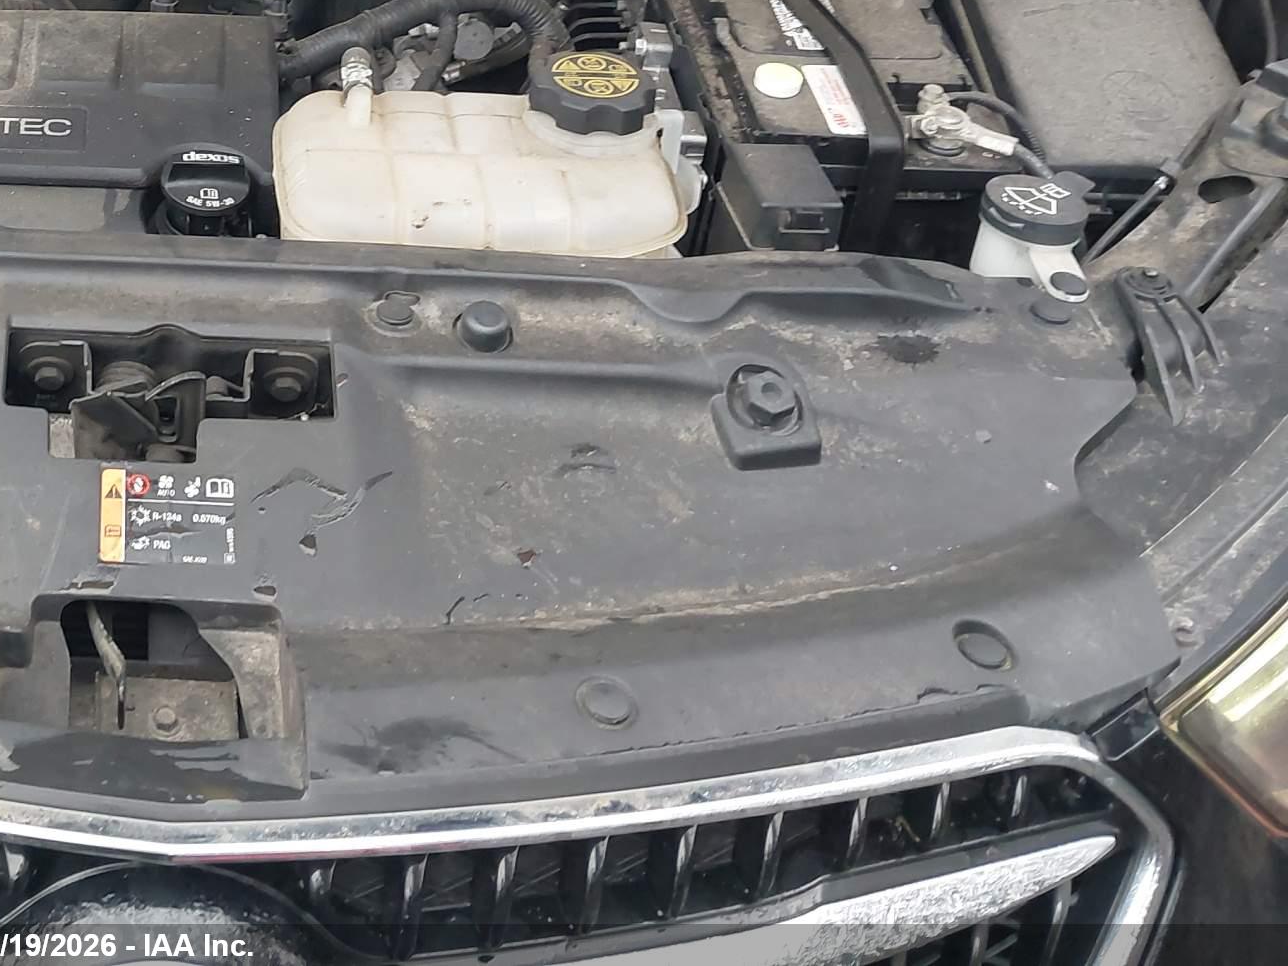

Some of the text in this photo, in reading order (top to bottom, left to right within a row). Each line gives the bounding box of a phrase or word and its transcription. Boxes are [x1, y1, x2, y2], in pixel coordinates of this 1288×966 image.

[182, 151, 240, 164] dexos
[186, 196, 235, 207] SAE 5W-30
[153, 540, 171, 549] PAG
